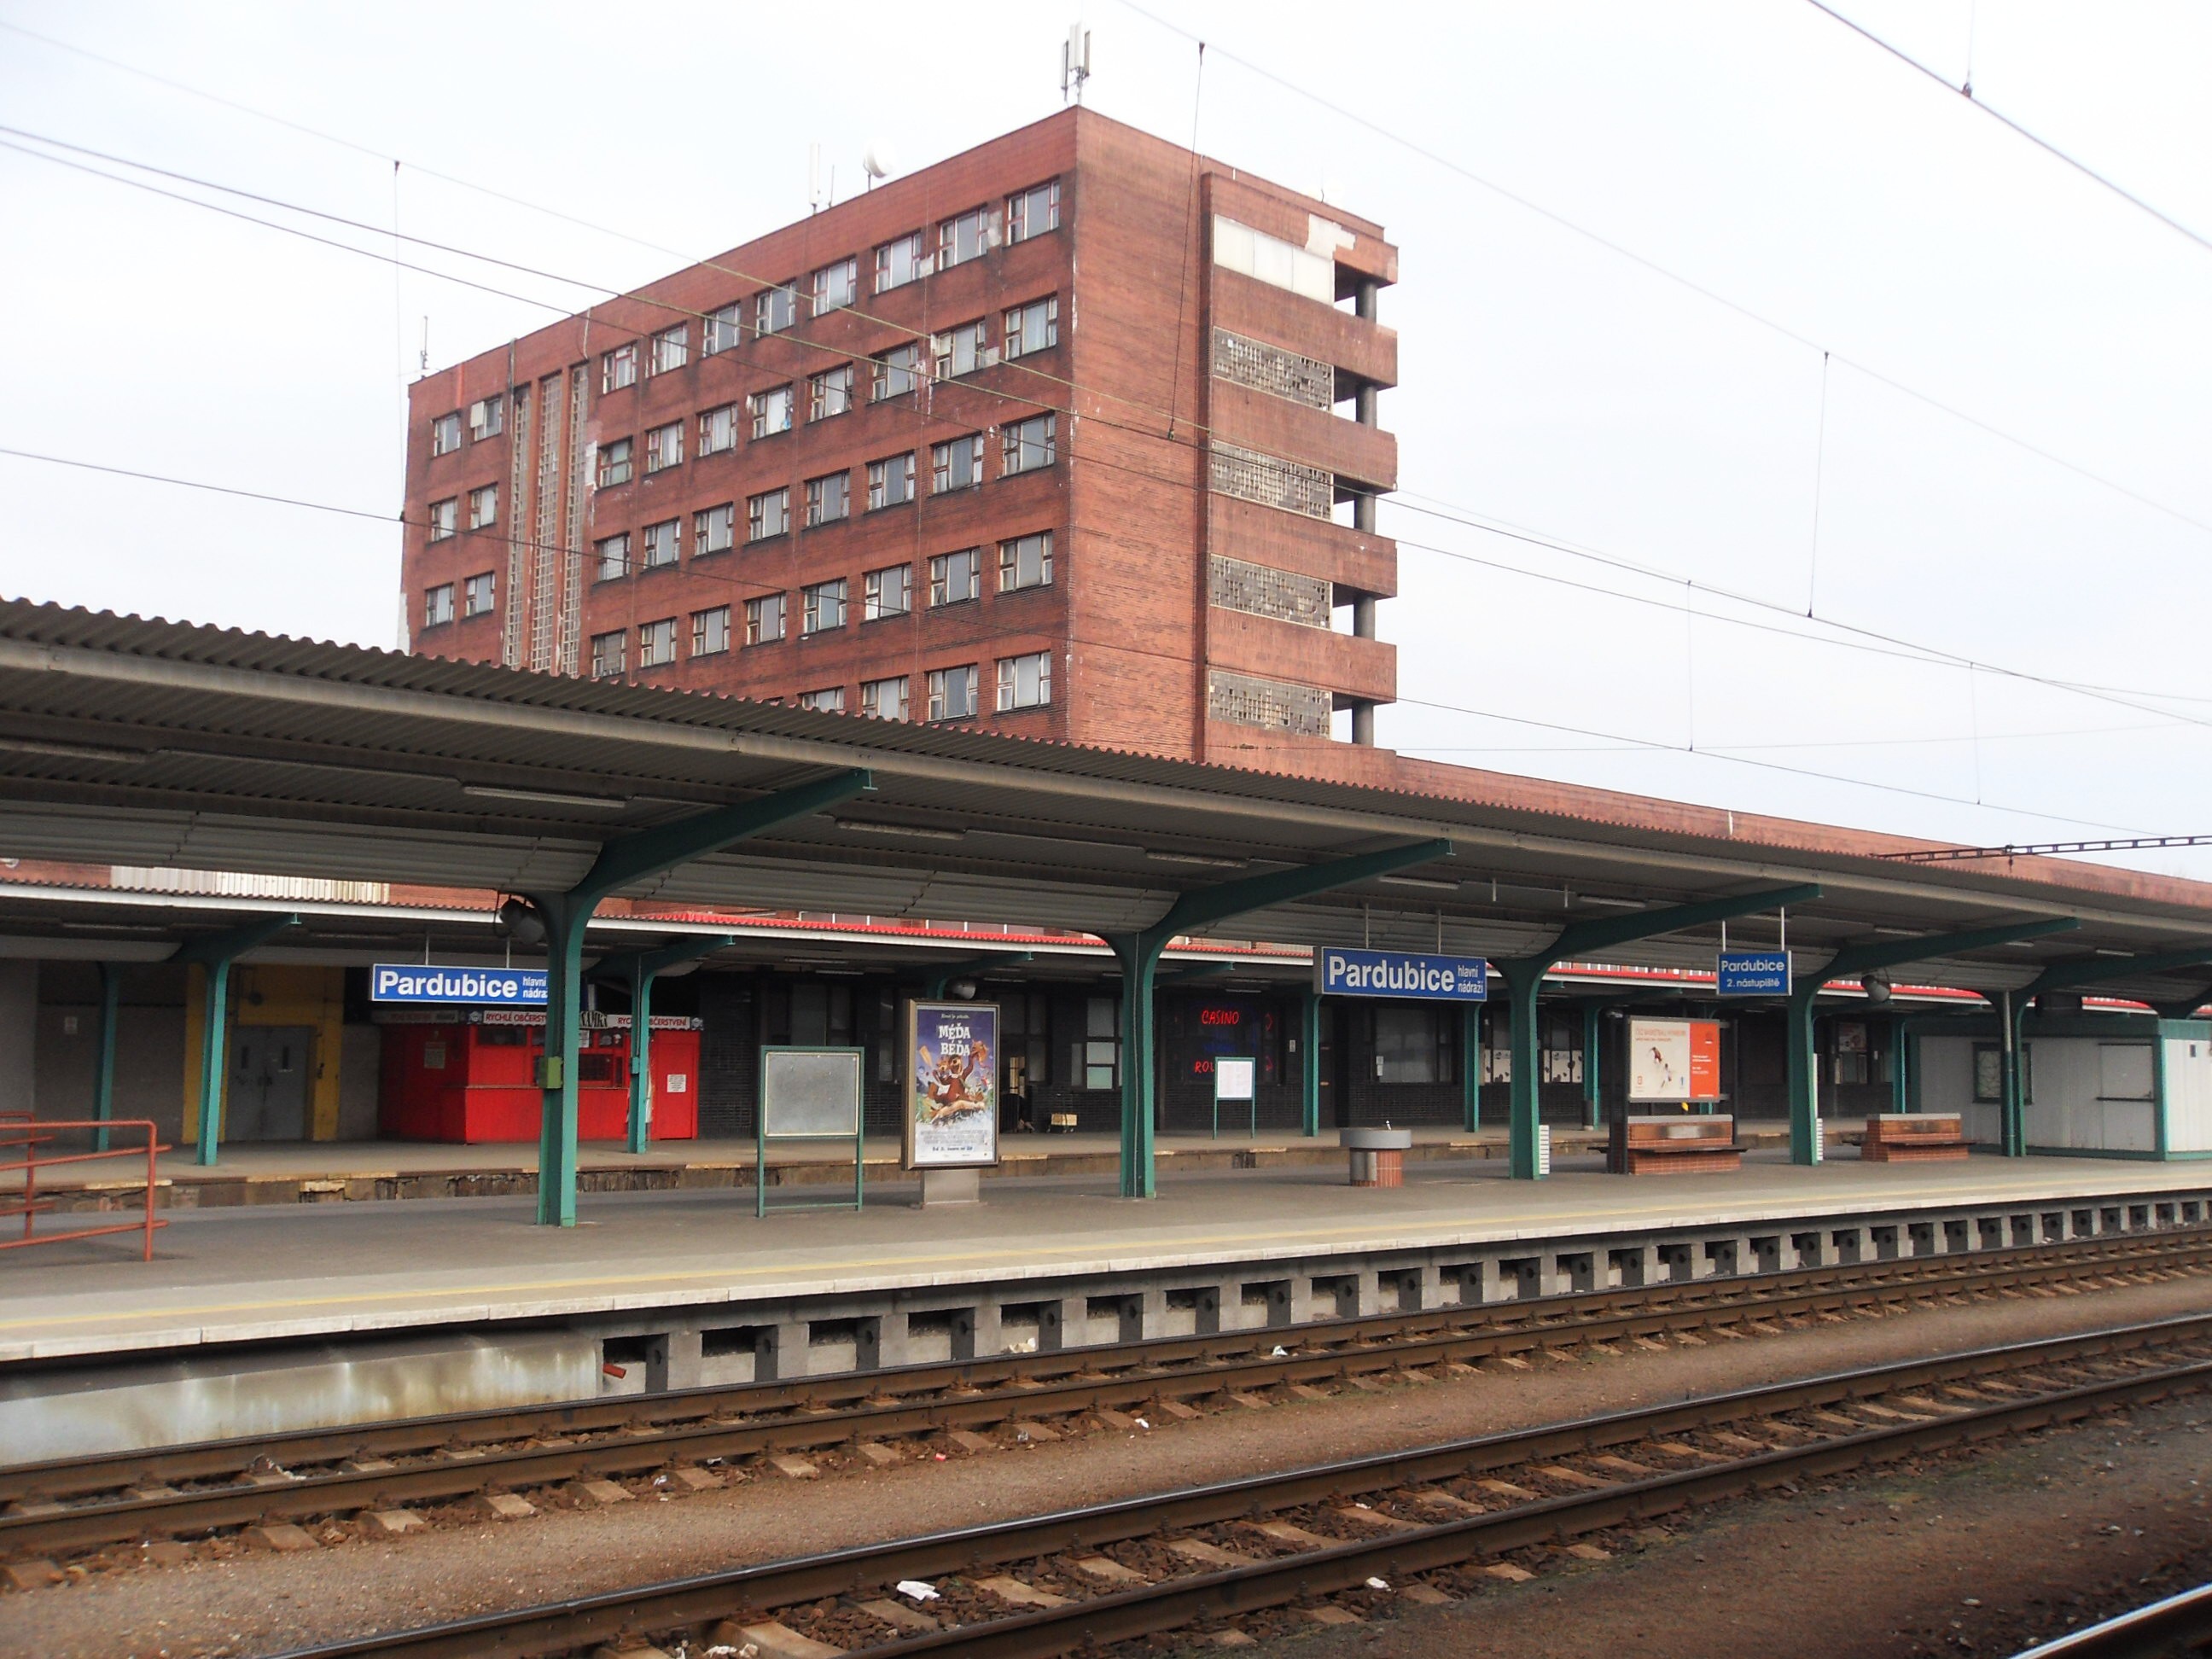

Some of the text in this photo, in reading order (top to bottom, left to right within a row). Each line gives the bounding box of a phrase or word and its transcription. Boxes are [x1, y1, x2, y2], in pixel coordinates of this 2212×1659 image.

[1458, 964, 1479, 978] hlavní
[1720, 959, 1785, 972] Pardubice
[522, 975, 547, 987] hlavní
[1329, 956, 1455, 992] Pardubice
[379, 970, 518, 998] Pardubice
[1458, 980, 1484, 993] nádraží
[1726, 978, 1780, 989] 2. nástupiště
[514, 1012, 547, 1023] OBČERST
[1201, 1010, 1241, 1025] CASINO
[939, 1022, 971, 1039] MÉĎA
[940, 1039, 970, 1057] BÉĎA
